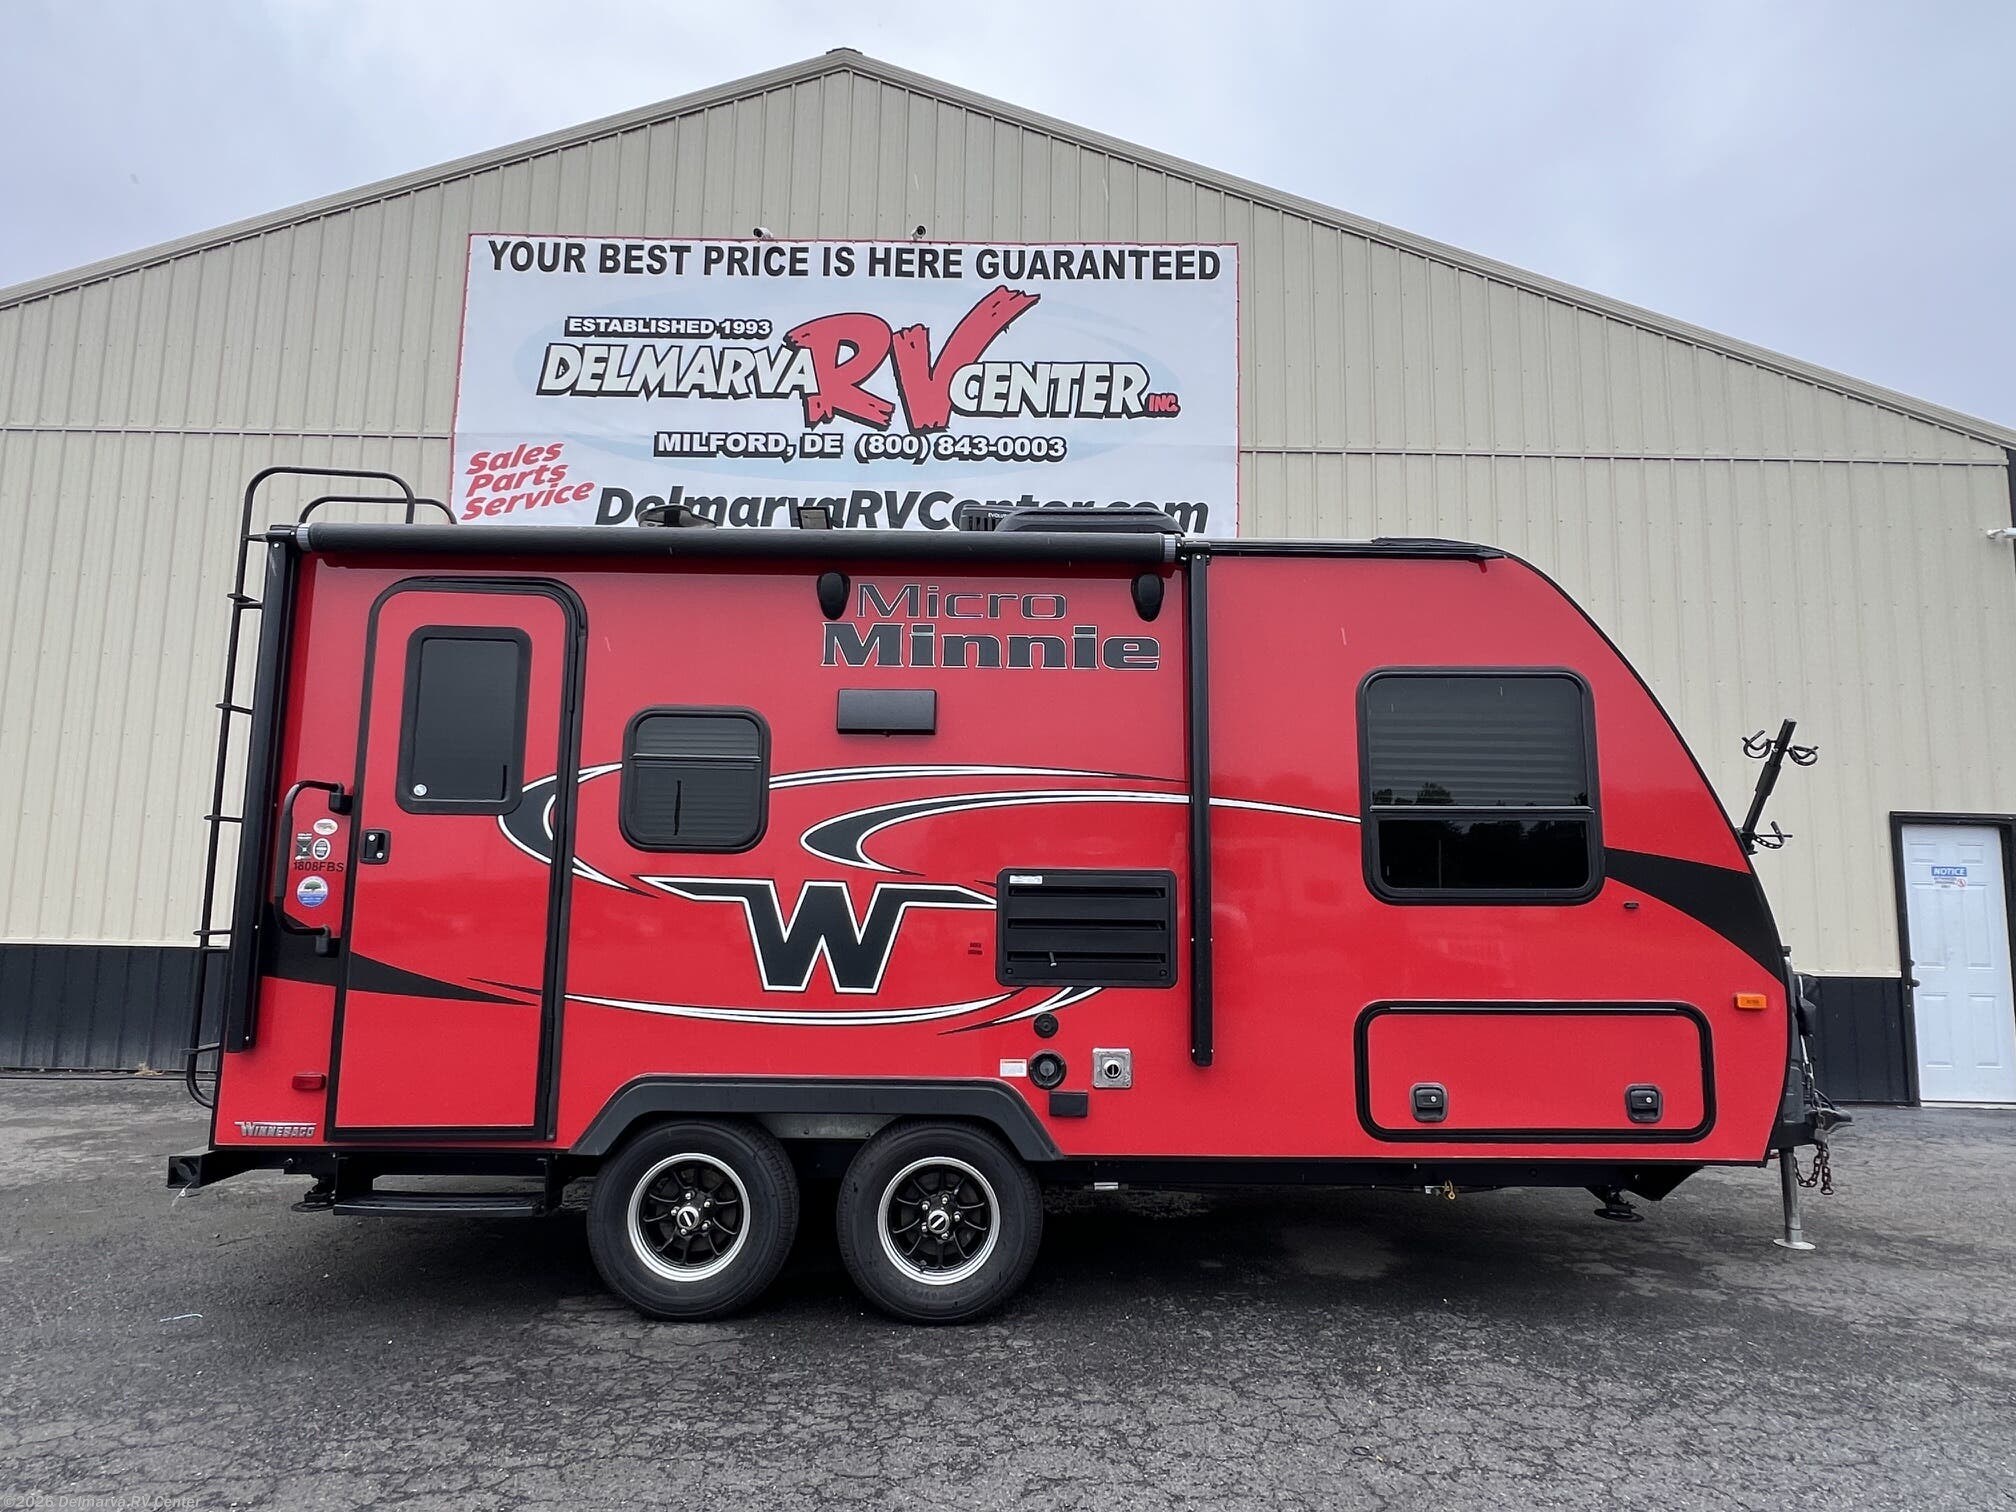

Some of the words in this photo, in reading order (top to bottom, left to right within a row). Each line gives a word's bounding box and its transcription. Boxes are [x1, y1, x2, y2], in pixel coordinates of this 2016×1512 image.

[488, 240, 587, 274] YOUR
[599, 245, 692, 275] BEST
[704, 246, 809, 277] PRICE
[823, 247, 855, 277] IS
[868, 247, 964, 279] HERE
[976, 250, 1221, 280] GUARANTEED
[566, 316, 716, 337] ESTABLISHED
[718, 318, 773, 337] 1993
[537, 344, 821, 400] DELMARVA
[784, 285, 1041, 435] RV
[948, 361, 1151, 418] CENTER
[465, 443, 565, 475] Sales
[654, 431, 797, 463] MILFORD,
[799, 433, 844, 458] DE
[855, 433, 930, 464] (800)
[934, 436, 1067, 462] 843-0003
[466, 464, 569, 497] Parts
[461, 482, 595, 520] Service
[595, 486, 1209, 533] DmarvaRVCm
[857, 584, 1067, 619] Micro
[820, 622, 1160, 670] Minnie
[234, 1121, 317, 1138] WINNEBAGO
